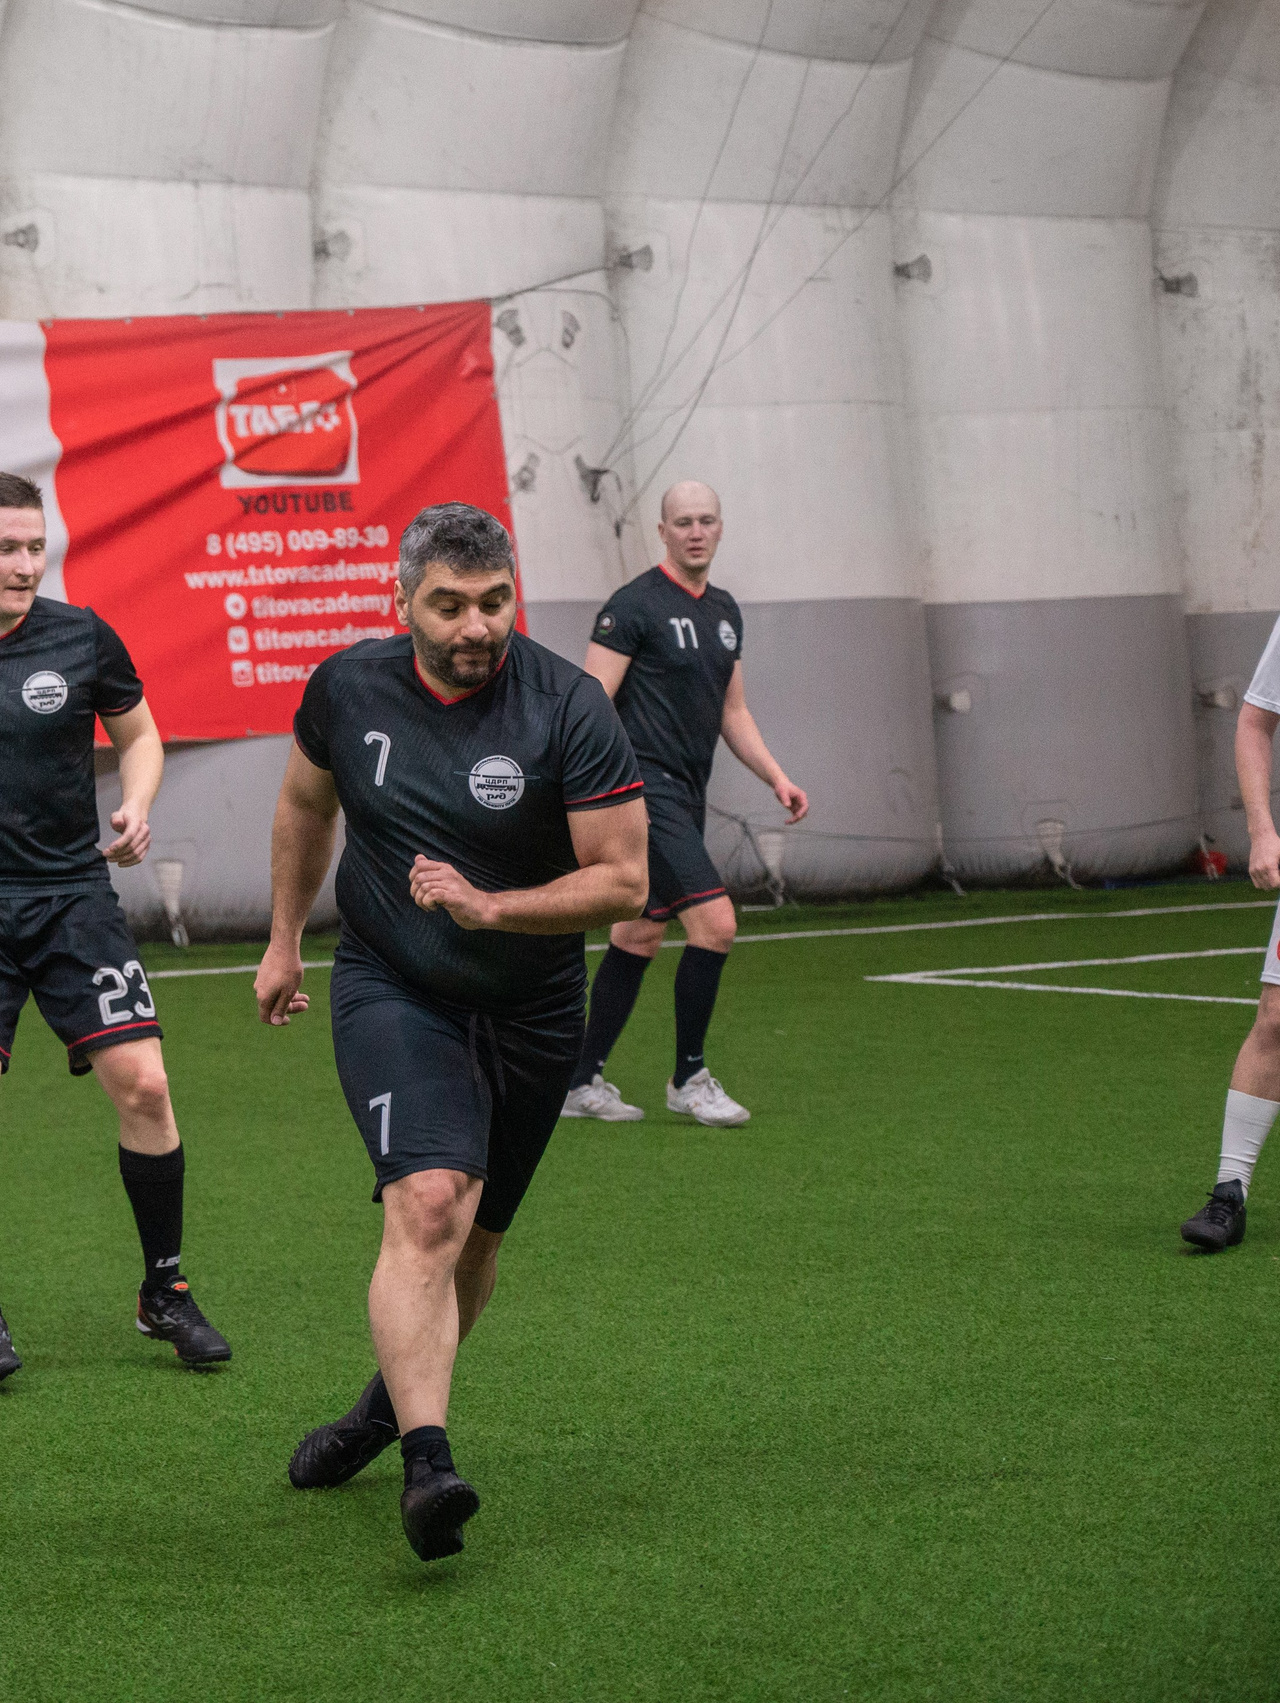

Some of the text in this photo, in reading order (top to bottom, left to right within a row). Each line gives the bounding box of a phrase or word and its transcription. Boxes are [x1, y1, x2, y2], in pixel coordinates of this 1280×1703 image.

[238, 490, 355, 516] YOUTUBE
[206, 533, 222, 556] 8
[225, 530, 284, 559] (495)
[251, 591, 393, 619] titovacademy
[363, 731, 391, 787] 7
[92, 960, 156, 1025] 23
